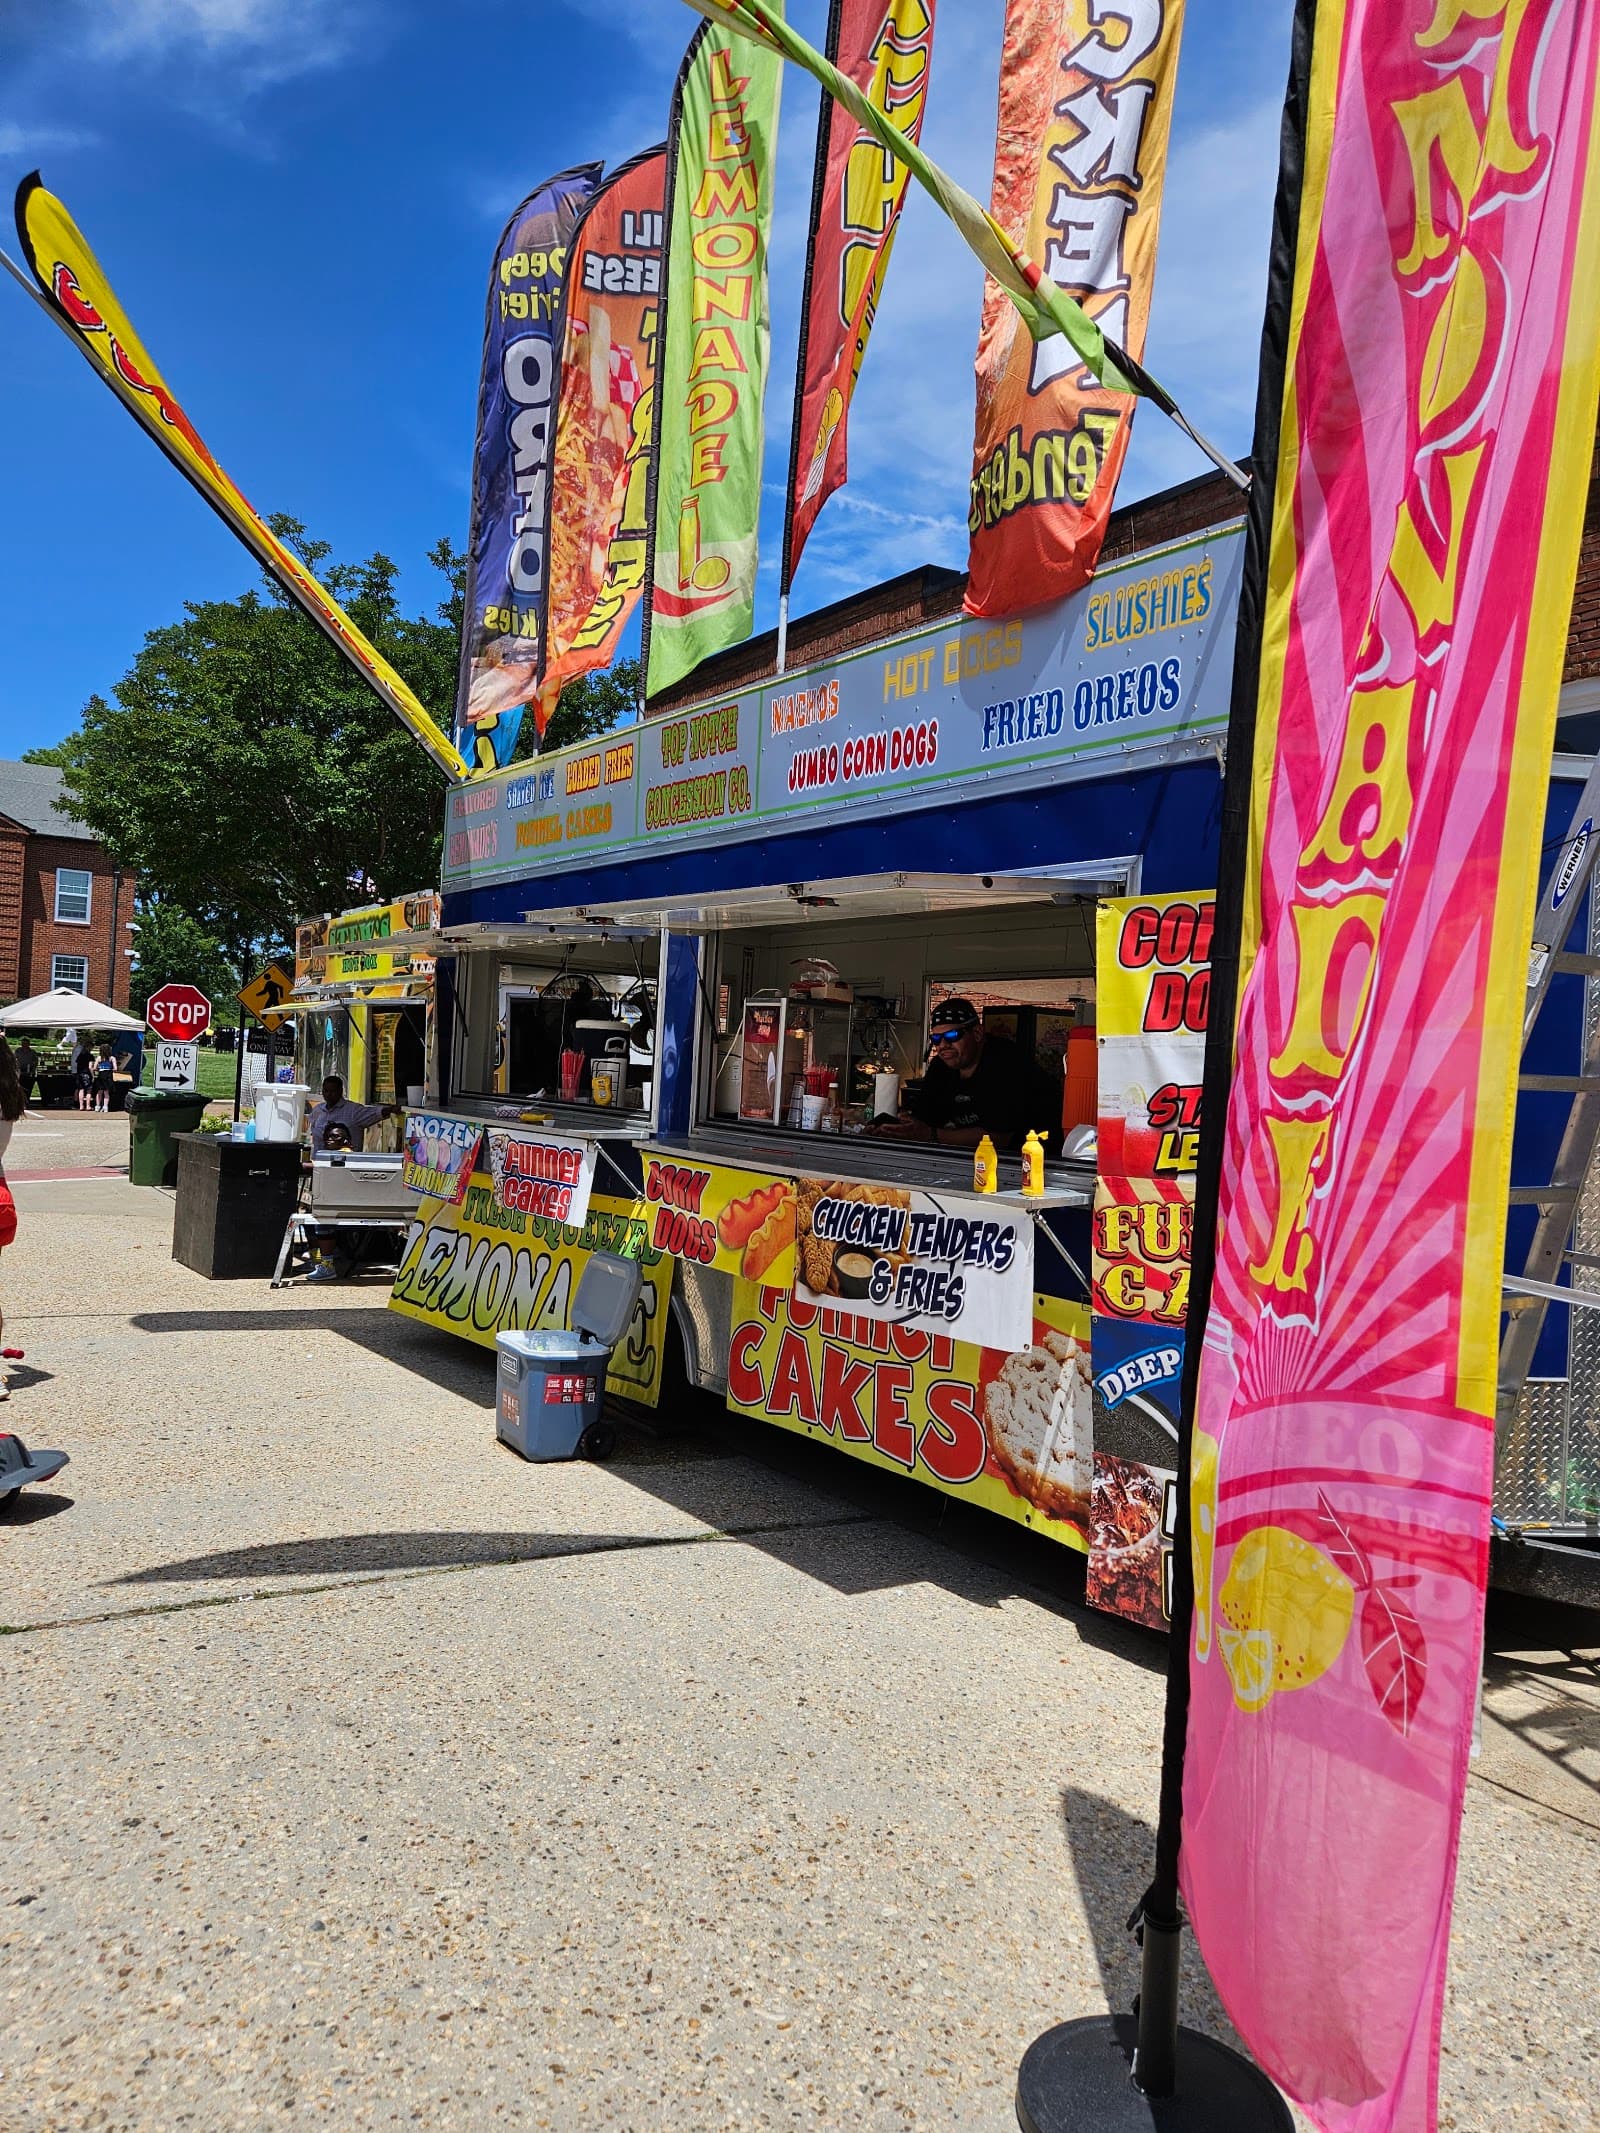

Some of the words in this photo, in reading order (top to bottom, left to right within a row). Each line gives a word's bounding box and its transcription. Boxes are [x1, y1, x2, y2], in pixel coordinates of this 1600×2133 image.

[685, 48, 758, 489] LEMONADE
[1086, 558, 1214, 652] SLUSHIES
[883, 646, 935, 704] HOT
[943, 619, 1023, 686] DOGS
[770, 679, 840, 737] NACHOS
[981, 688, 1065, 753] FRIED
[1073, 655, 1183, 733] OREOS
[661, 720, 689, 769] TOP
[689, 703, 739, 761] NOTCH
[786, 736, 840, 795] JUMBO
[841, 728, 889, 784] CORN
[888, 716, 939, 772] DOGS
[506, 775, 537, 811] SHAVED
[565, 753, 601, 796] LOADED
[603, 742, 634, 785] FRIES
[645, 770, 727, 832] CONCESSION
[728, 764, 752, 814] CO.
[453, 785, 498, 819] FLAVORED
[565, 801, 613, 841] CAKES
[1558, 835, 1587, 892] WERNER
[1119, 901, 1217, 969] CO
[152, 1001, 206, 1026] STOP
[1142, 970, 1212, 1033] DO
[162, 1060, 191, 1071] WAY
[163, 1047, 190, 1059] ONE
[405, 1115, 482, 1150] FROZEN
[647, 1160, 712, 1214] CORN
[654, 1207, 718, 1265] DOGS
[812, 1196, 905, 1252] CHICKEN
[909, 1211, 1017, 1273] TENDERS
[869, 1256, 894, 1304] &
[896, 1264, 965, 1323] FRIES
[728, 1321, 986, 1484] CAKES
[1098, 1348, 1181, 1404] DEEP
